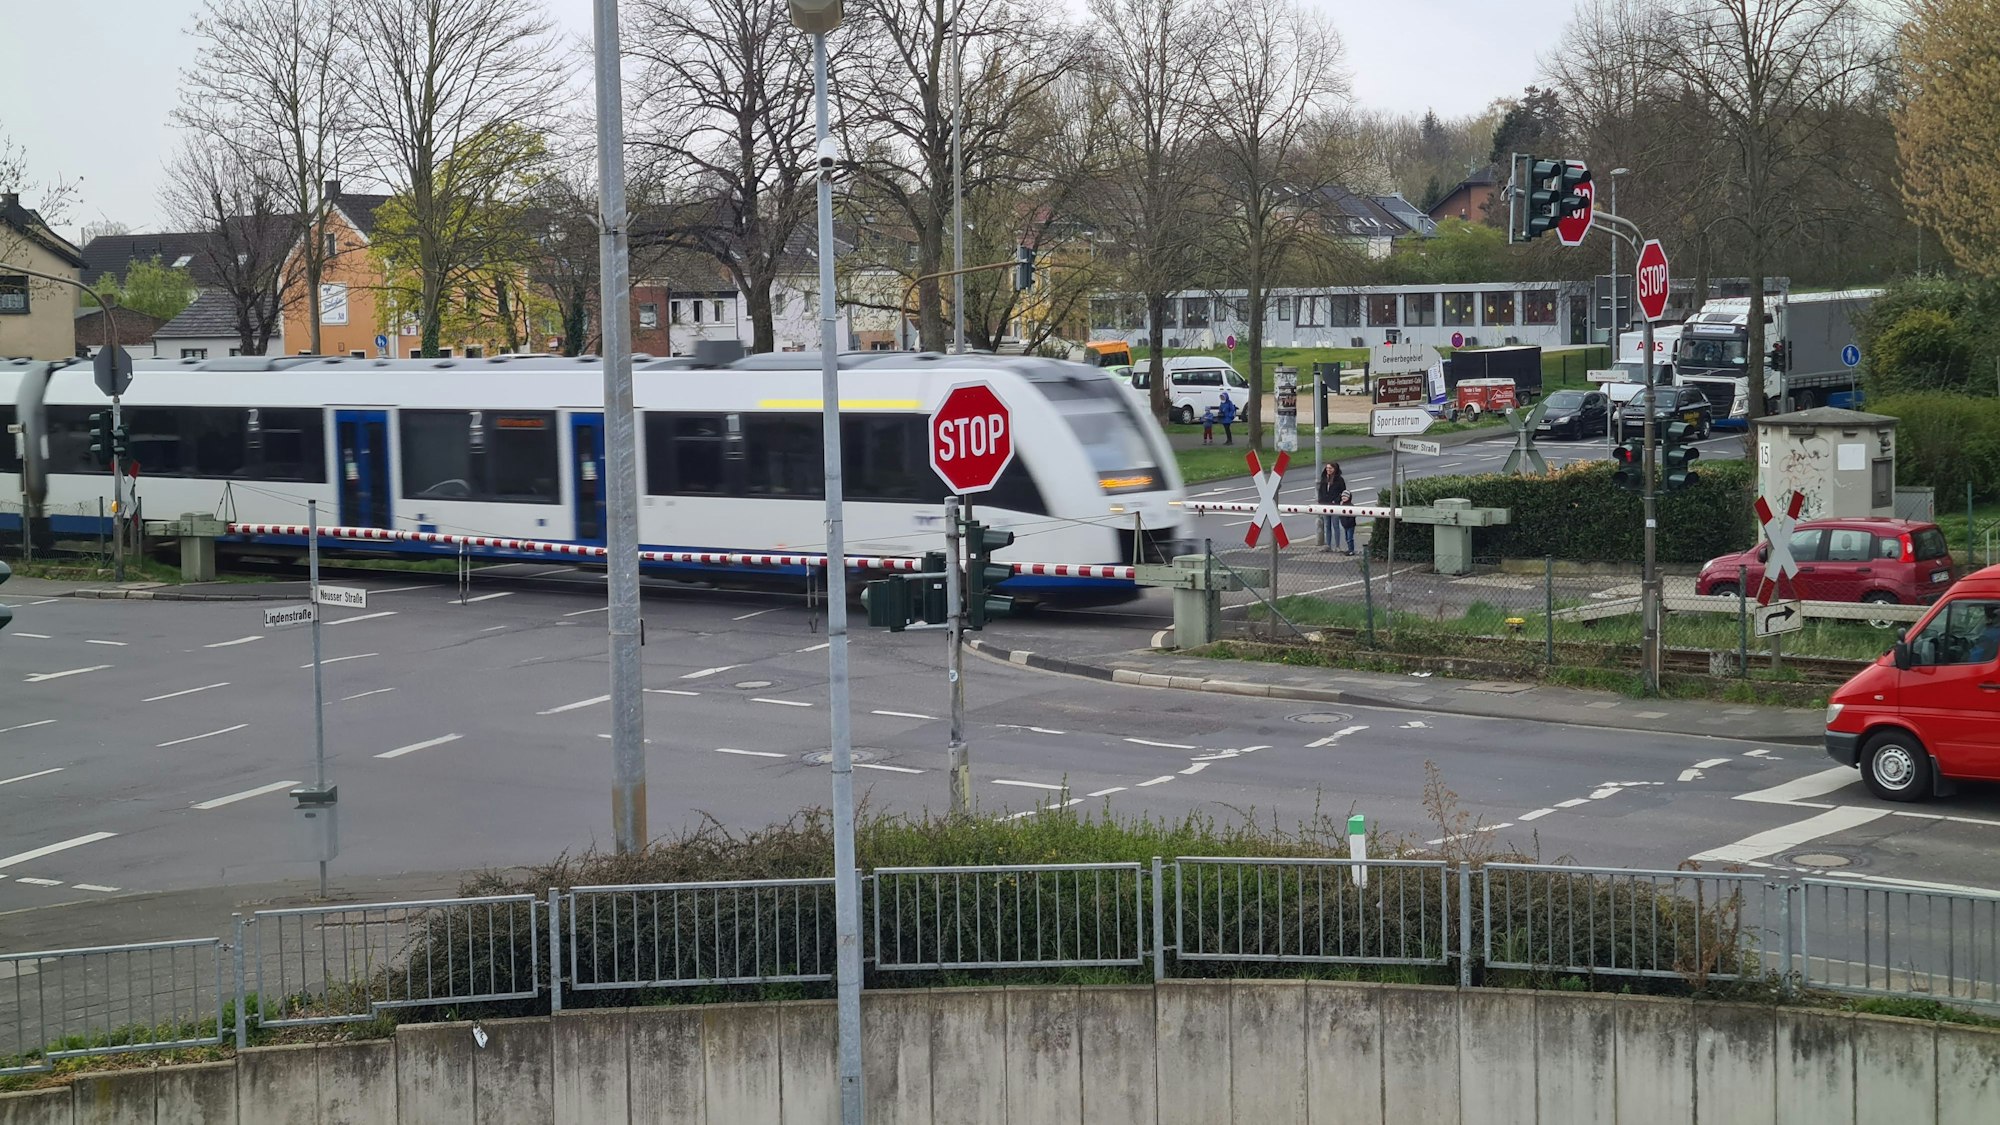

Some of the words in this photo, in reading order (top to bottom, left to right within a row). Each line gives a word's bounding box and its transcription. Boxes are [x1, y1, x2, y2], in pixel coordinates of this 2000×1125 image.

[1640, 264, 1666, 298] STOP
[1636, 341, 1664, 351] AIS
[1382, 354, 1424, 364] Gewerbegebiet
[1376, 416, 1420, 429] Sportzentrum
[938, 413, 1005, 461] STOP
[1399, 441, 1419, 451] Neusser
[1421, 443, 1437, 453] Straße
[1760, 446, 1769, 465] 15
[320, 589, 342, 602] Neusser
[344, 591, 363, 604] Straße
[265, 608, 312, 624] Lindenstraße
